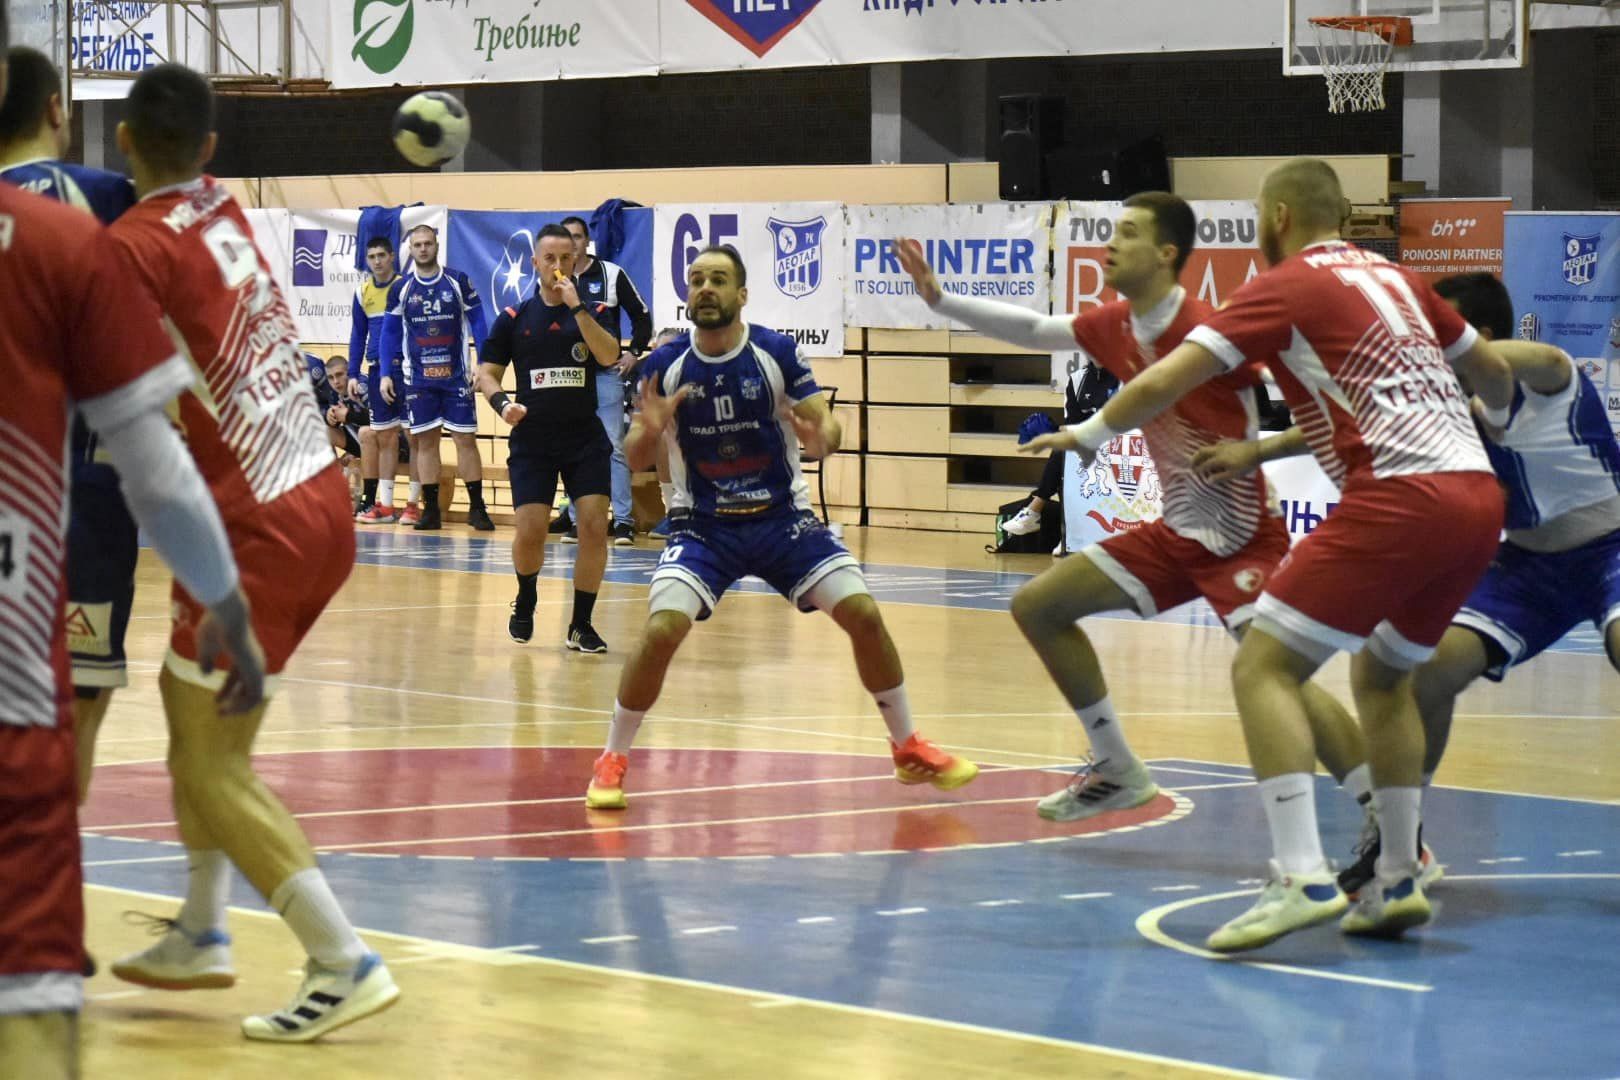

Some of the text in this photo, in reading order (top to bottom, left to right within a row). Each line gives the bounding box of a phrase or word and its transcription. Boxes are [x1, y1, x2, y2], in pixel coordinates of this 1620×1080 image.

[473, 14, 581, 60] Требиње
[71, 33, 154, 71] РЕБИЊЕ
[1070, 218, 1256, 243] TVO OBU
[777, 247, 817, 274] ЛЕОТАР
[1402, 249, 1503, 261] PONOSNI PARTNER
[855, 280, 1035, 296] IT SOLUTI AND SERVICES
[423, 299, 442, 315] 24
[774, 329, 829, 345] ЕБИЊУ
[713, 395, 735, 422] 10
